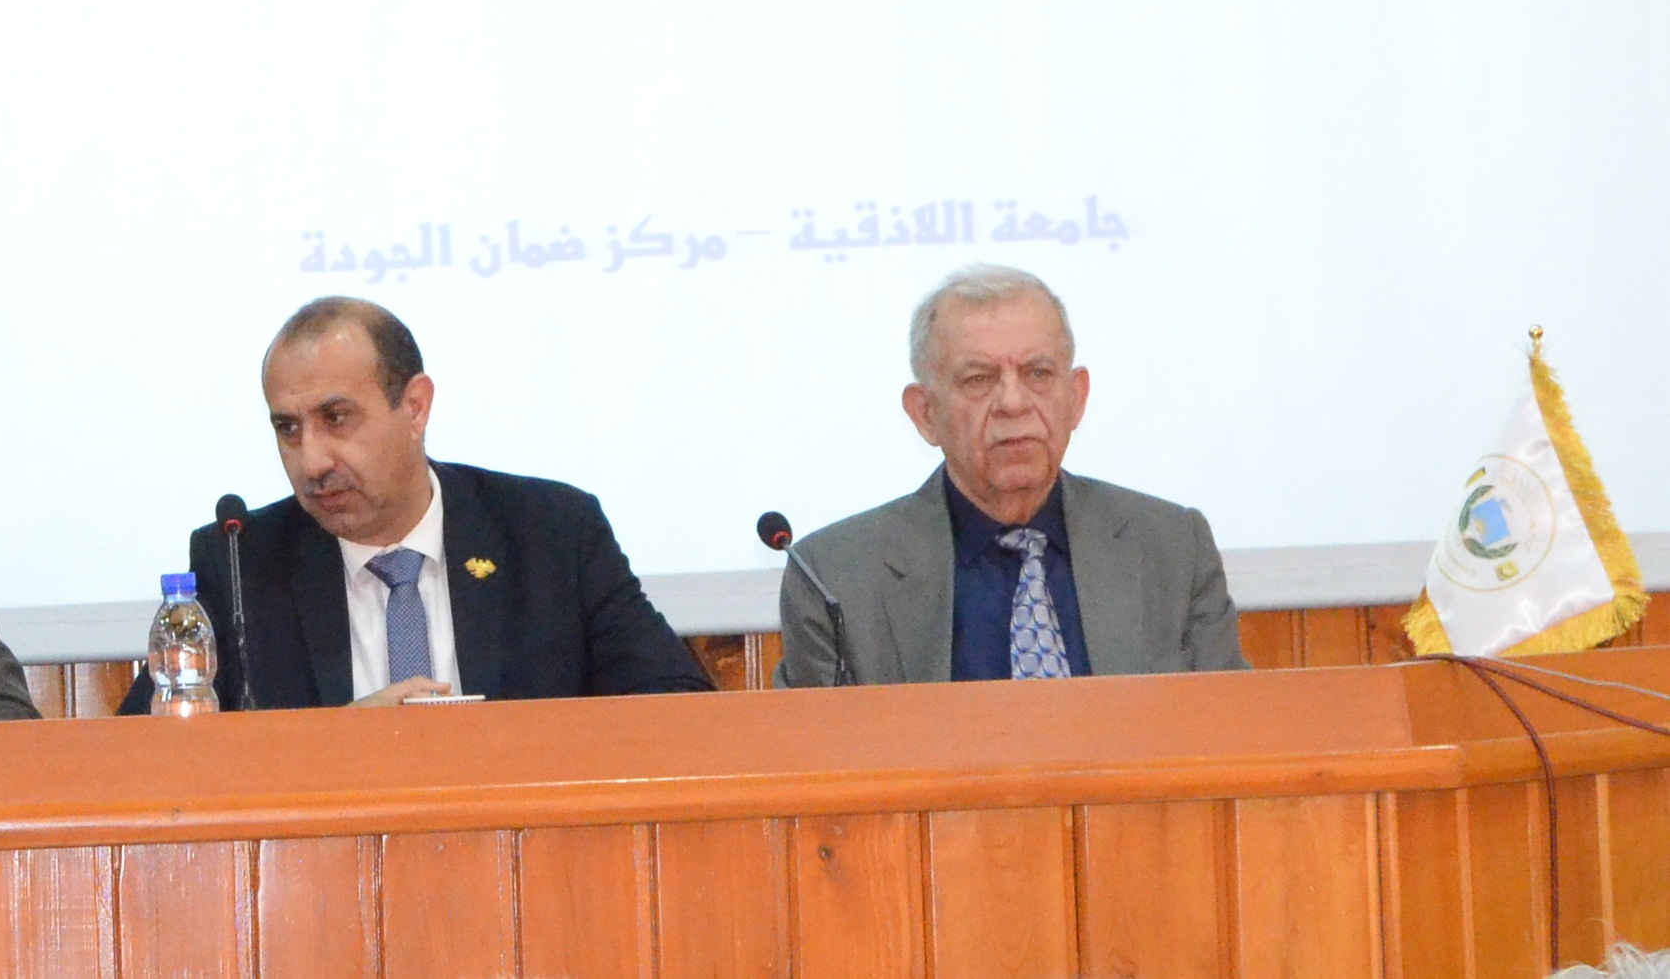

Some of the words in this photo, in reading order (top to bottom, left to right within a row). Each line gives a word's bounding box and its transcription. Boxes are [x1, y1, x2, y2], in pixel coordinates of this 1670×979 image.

[300, 221, 453, 285] الجودة
[469, 219, 587, 279] ضمان
[603, 215, 728, 273] مركز
[789, 199, 976, 263] اللاذقية
[991, 195, 1129, 251] جامعة
